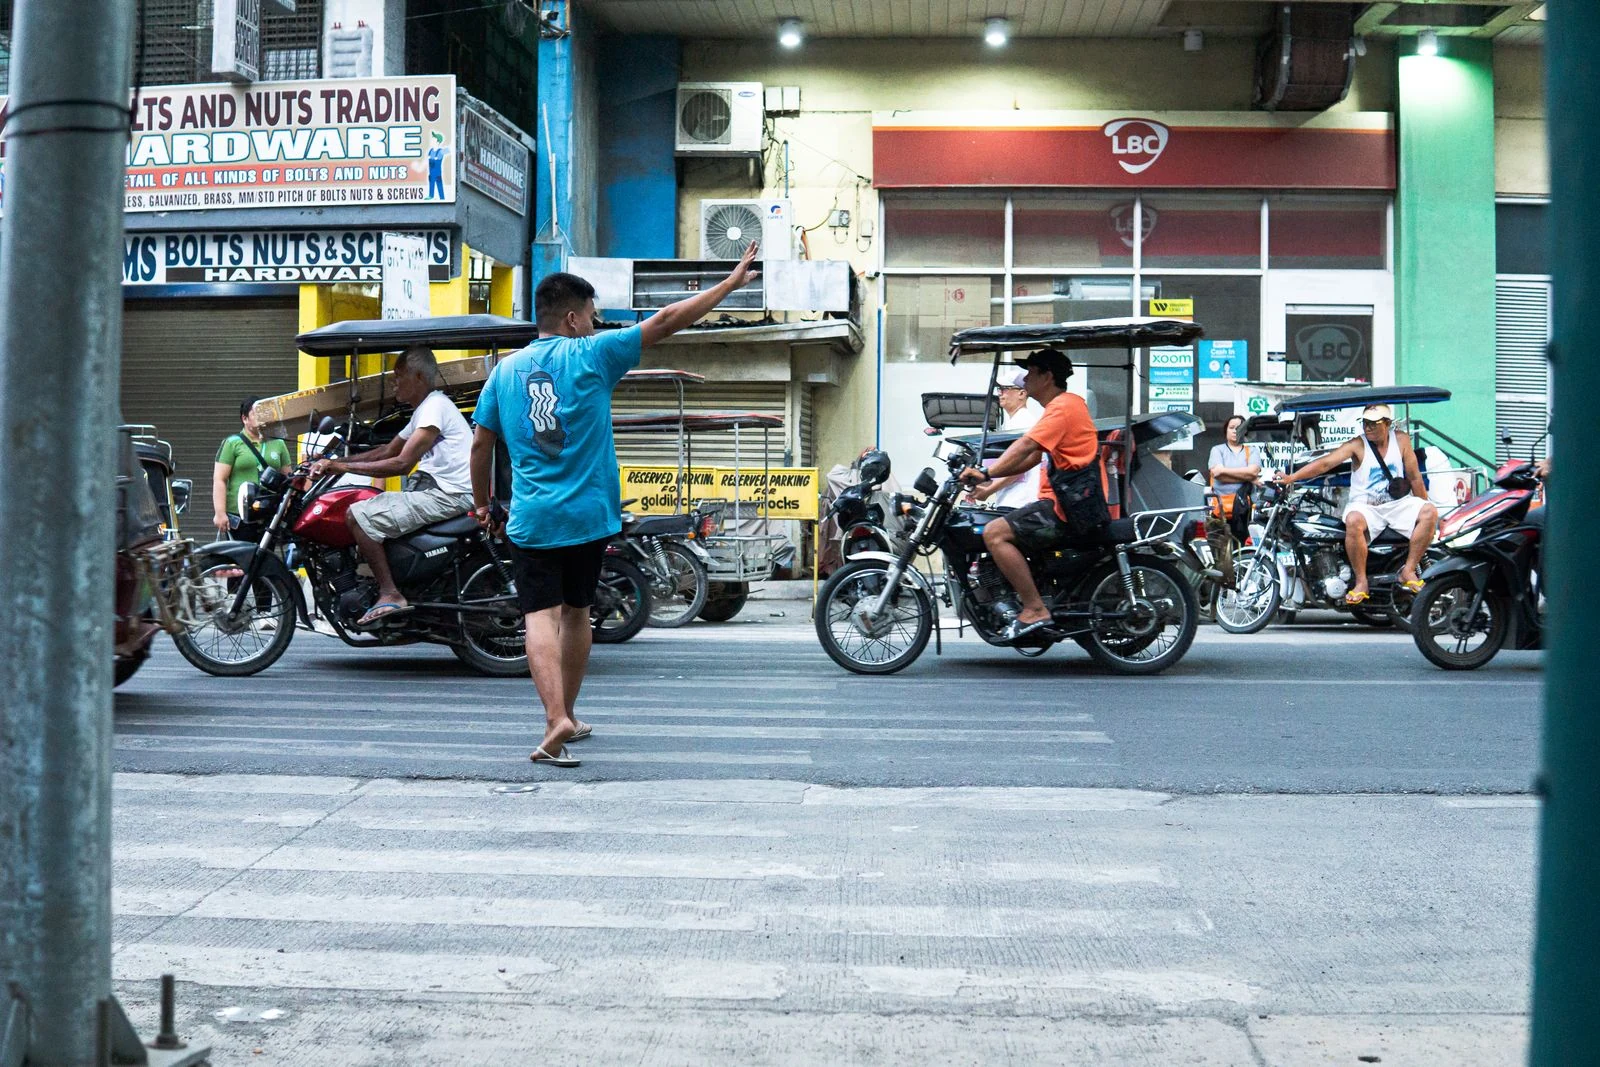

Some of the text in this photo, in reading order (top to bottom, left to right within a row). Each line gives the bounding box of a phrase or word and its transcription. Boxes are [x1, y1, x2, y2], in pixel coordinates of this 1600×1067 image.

[180, 94, 236, 129] AND
[245, 90, 313, 127] NUTS
[320, 86, 439, 124] TRADING
[126, 126, 422, 166] ARDWARE
[1112, 135, 1161, 154] LBC
[162, 172, 179, 186] OF
[184, 171, 208, 186] ALL
[214, 170, 256, 185] KINDS
[262, 169, 279, 183] OF
[285, 167, 329, 182] BOLTS
[334, 166, 363, 181] AND
[369, 165, 408, 180] NUTS
[480, 148, 523, 189] HARDWARE
[149, 194, 200, 207] GALVANIZED,
[204, 193, 235, 205] BRASS,
[278, 190, 303, 202] PITCH
[307, 189, 316, 202] OF
[321, 189, 346, 201] BOLTS
[350, 188, 373, 200] NUTS
[377, 188, 383, 200] &
[387, 187, 424, 200] SCREWS
[165, 234, 244, 266] BOLTS
[1152, 354, 1191, 363] xoom
[1308, 342, 1351, 360] LBC
[627, 471, 673, 484] RESERVED
[769, 474, 811, 487] PARKING
[661, 485, 683, 493] FO
[424, 546, 448, 558] YAMAHA
